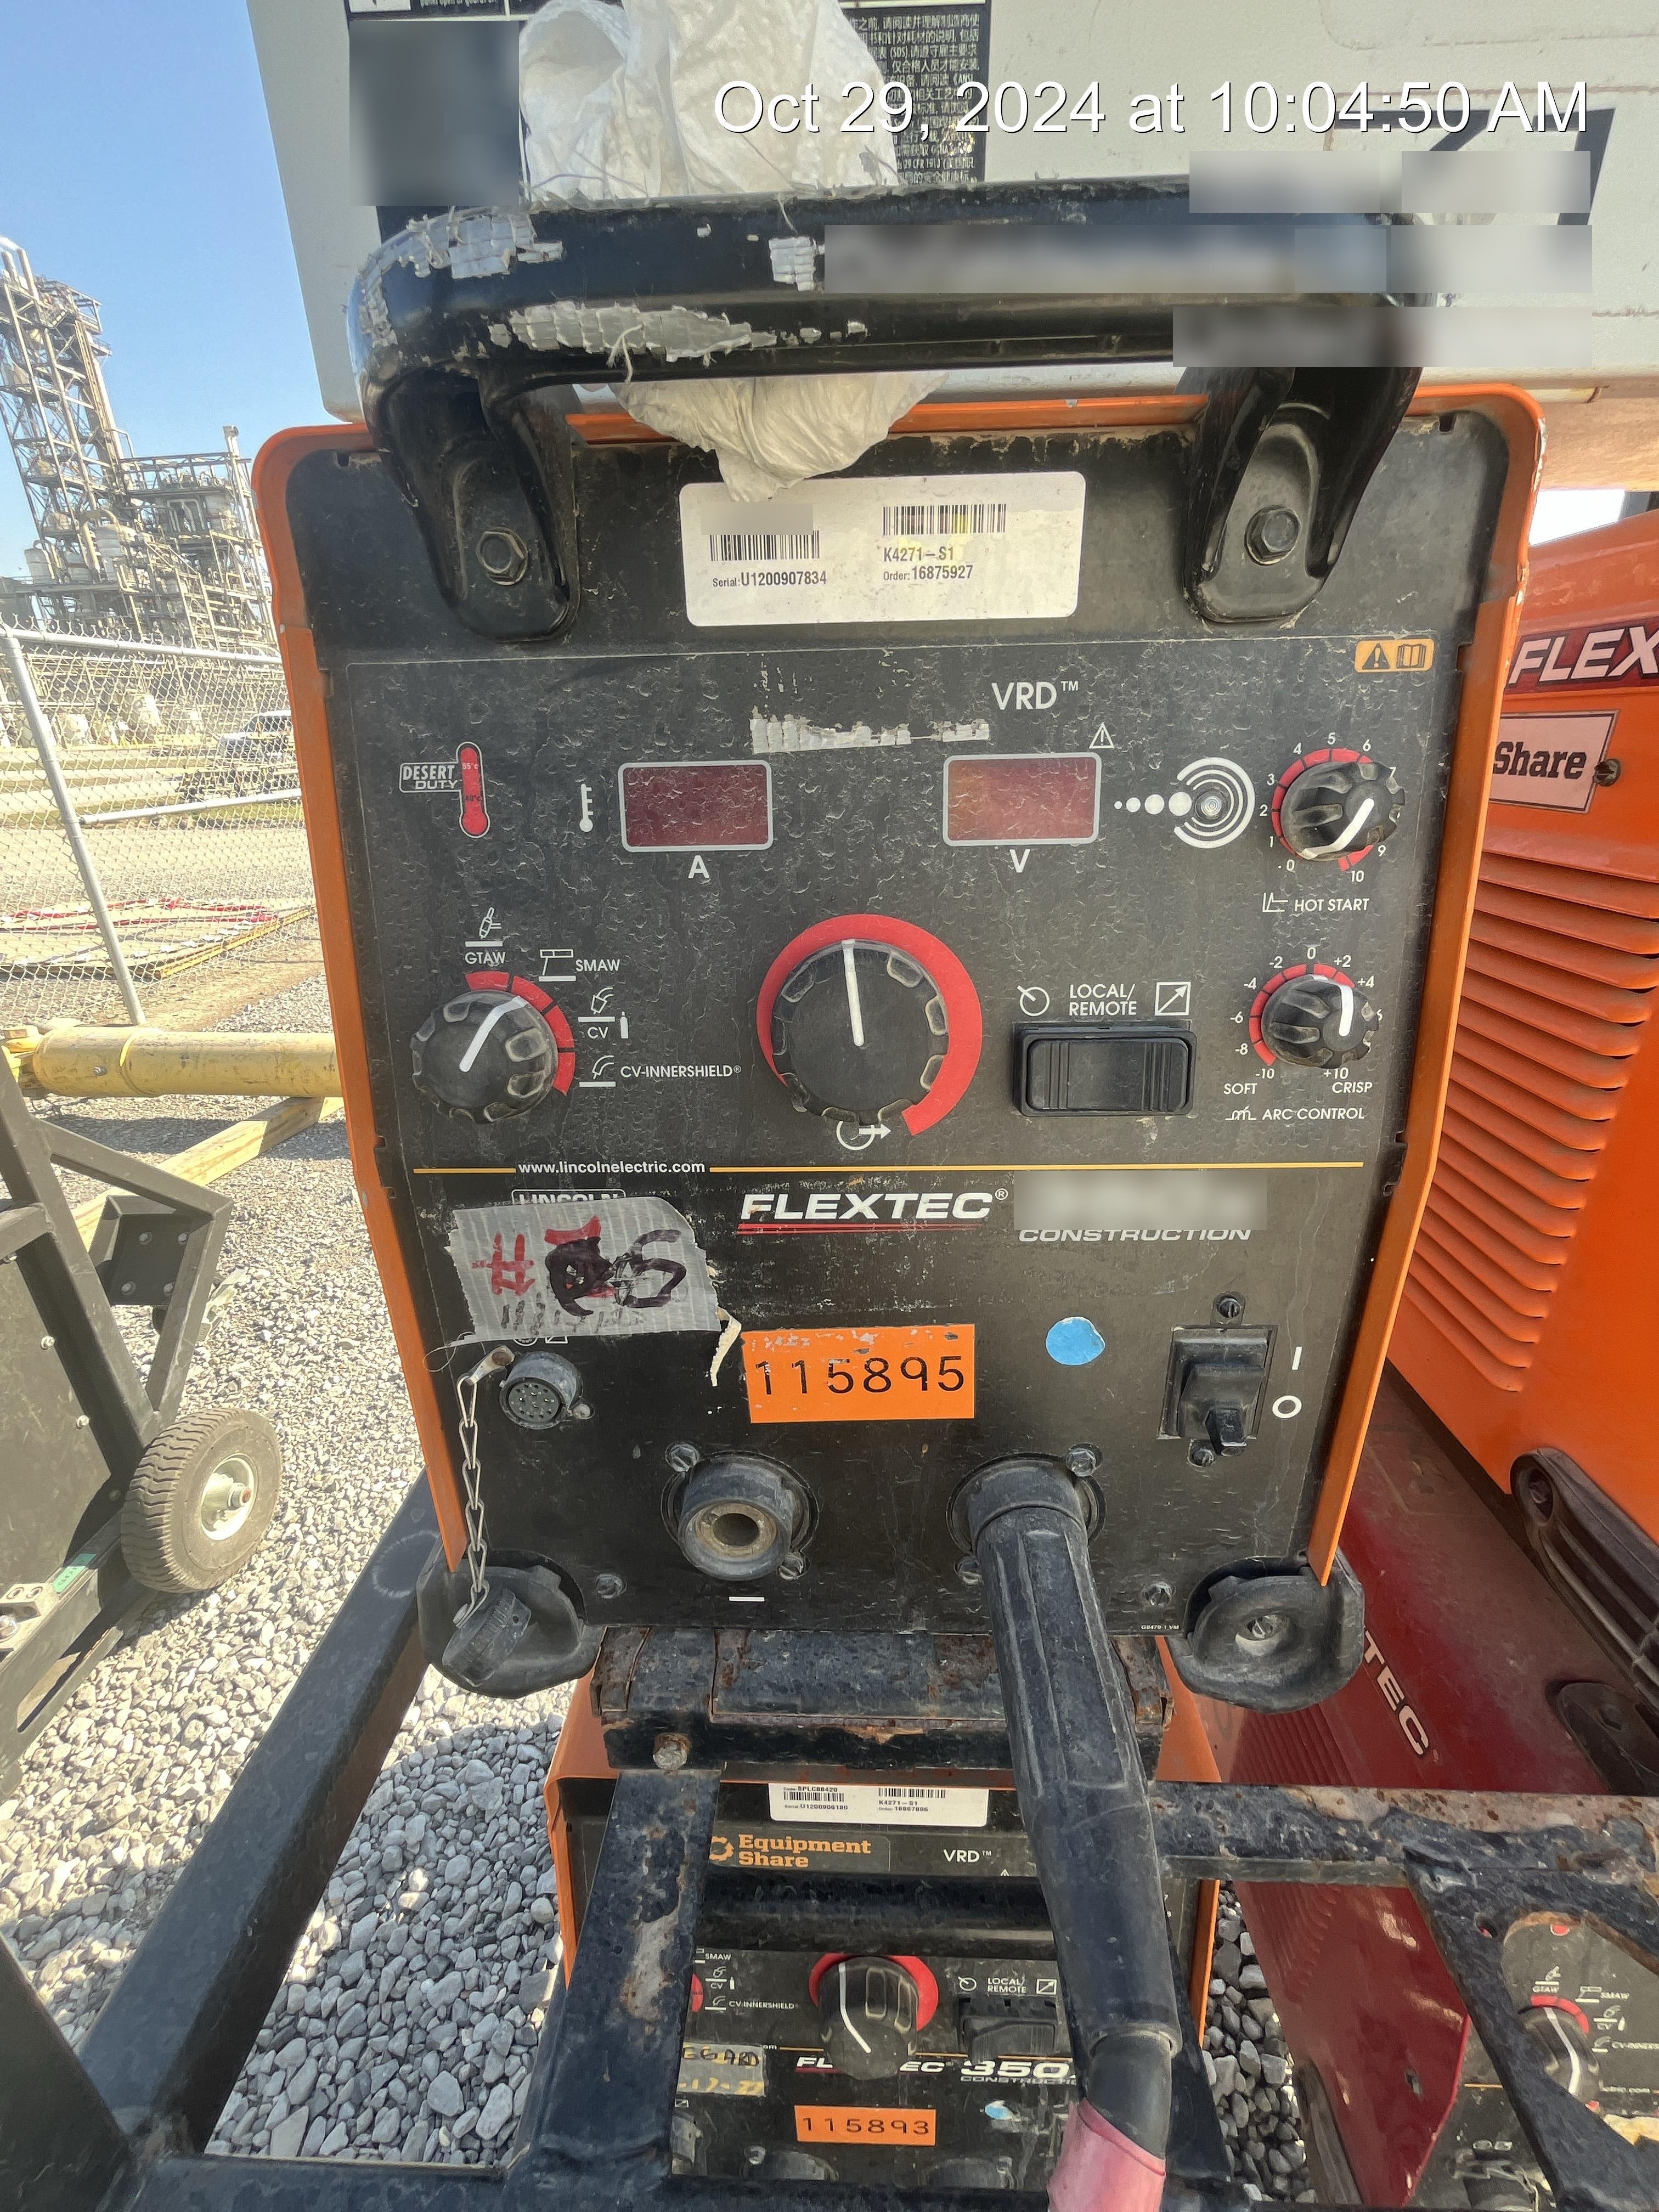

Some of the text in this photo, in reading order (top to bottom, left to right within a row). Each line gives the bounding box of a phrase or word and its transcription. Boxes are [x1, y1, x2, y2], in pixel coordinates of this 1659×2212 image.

[1328, 732, 1336, 744] 5
[1293, 743, 1302, 755] 4
[1362, 738, 1372, 752] 6
[1493, 741, 1587, 780] Share
[402, 765, 455, 781] DESERT
[1266, 773, 1276, 786] 3
[415, 780, 459, 790] DUTY
[1259, 804, 1268, 816] 2
[1269, 836, 1274, 847] 1
[1378, 845, 1387, 857] 9
[687, 855, 710, 879] A
[1009, 849, 1031, 873] V
[1351, 870, 1364, 883] 10
[1294, 898, 1370, 912] HOT START
[464, 951, 506, 966] GTAW
[1307, 947, 1316, 960] 0
[575, 958, 620, 972] SMAW
[1269, 956, 1283, 968] -2
[1334, 955, 1352, 968] +2
[1243, 977, 1257, 990] -4
[1357, 975, 1375, 988] +4
[1069, 983, 1136, 1001] LOCAL/
[1069, 1001, 1137, 1016] REMOTE
[1230, 1012, 1244, 1024] -6
[587, 1026, 609, 1039] CV
[1235, 1043, 1248, 1055] -8
[1255, 1068, 1275, 1080] -10
[1323, 1067, 1349, 1080] +10
[1223, 1083, 1257, 1095] SOFT
[1332, 1081, 1373, 1093] CRISP
[1262, 1107, 1365, 1120] ARC CONTROL
[518, 1161, 706, 1173] www.lincolnelectric.com
[1019, 1229, 1252, 1242] CONSTRUCTION
[755, 1356, 964, 1396] 115895
[738, 1834, 872, 1854] Equipment
[738, 1851, 809, 1867] Share
[988, 1985, 1026, 1994] REMOTE
[803, 2117, 929, 2136] 115893
